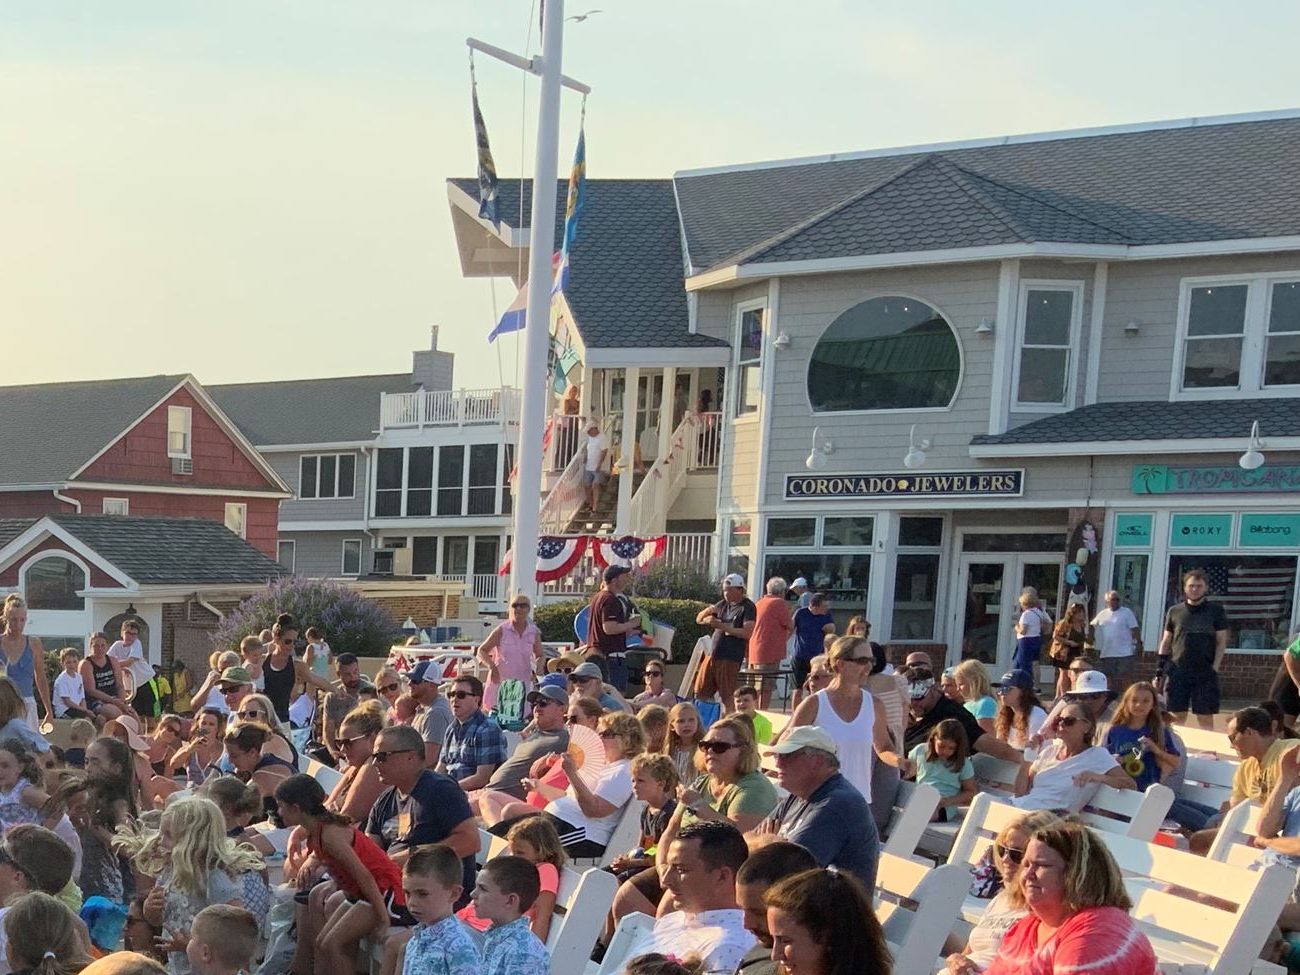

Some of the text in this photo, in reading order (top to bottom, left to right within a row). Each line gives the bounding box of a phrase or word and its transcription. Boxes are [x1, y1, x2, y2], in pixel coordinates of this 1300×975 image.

[789, 475, 1015, 494] CORONADO JEWELERS
[1192, 526, 1222, 535] ROXY
[1250, 524, 1291, 536] Billabong
